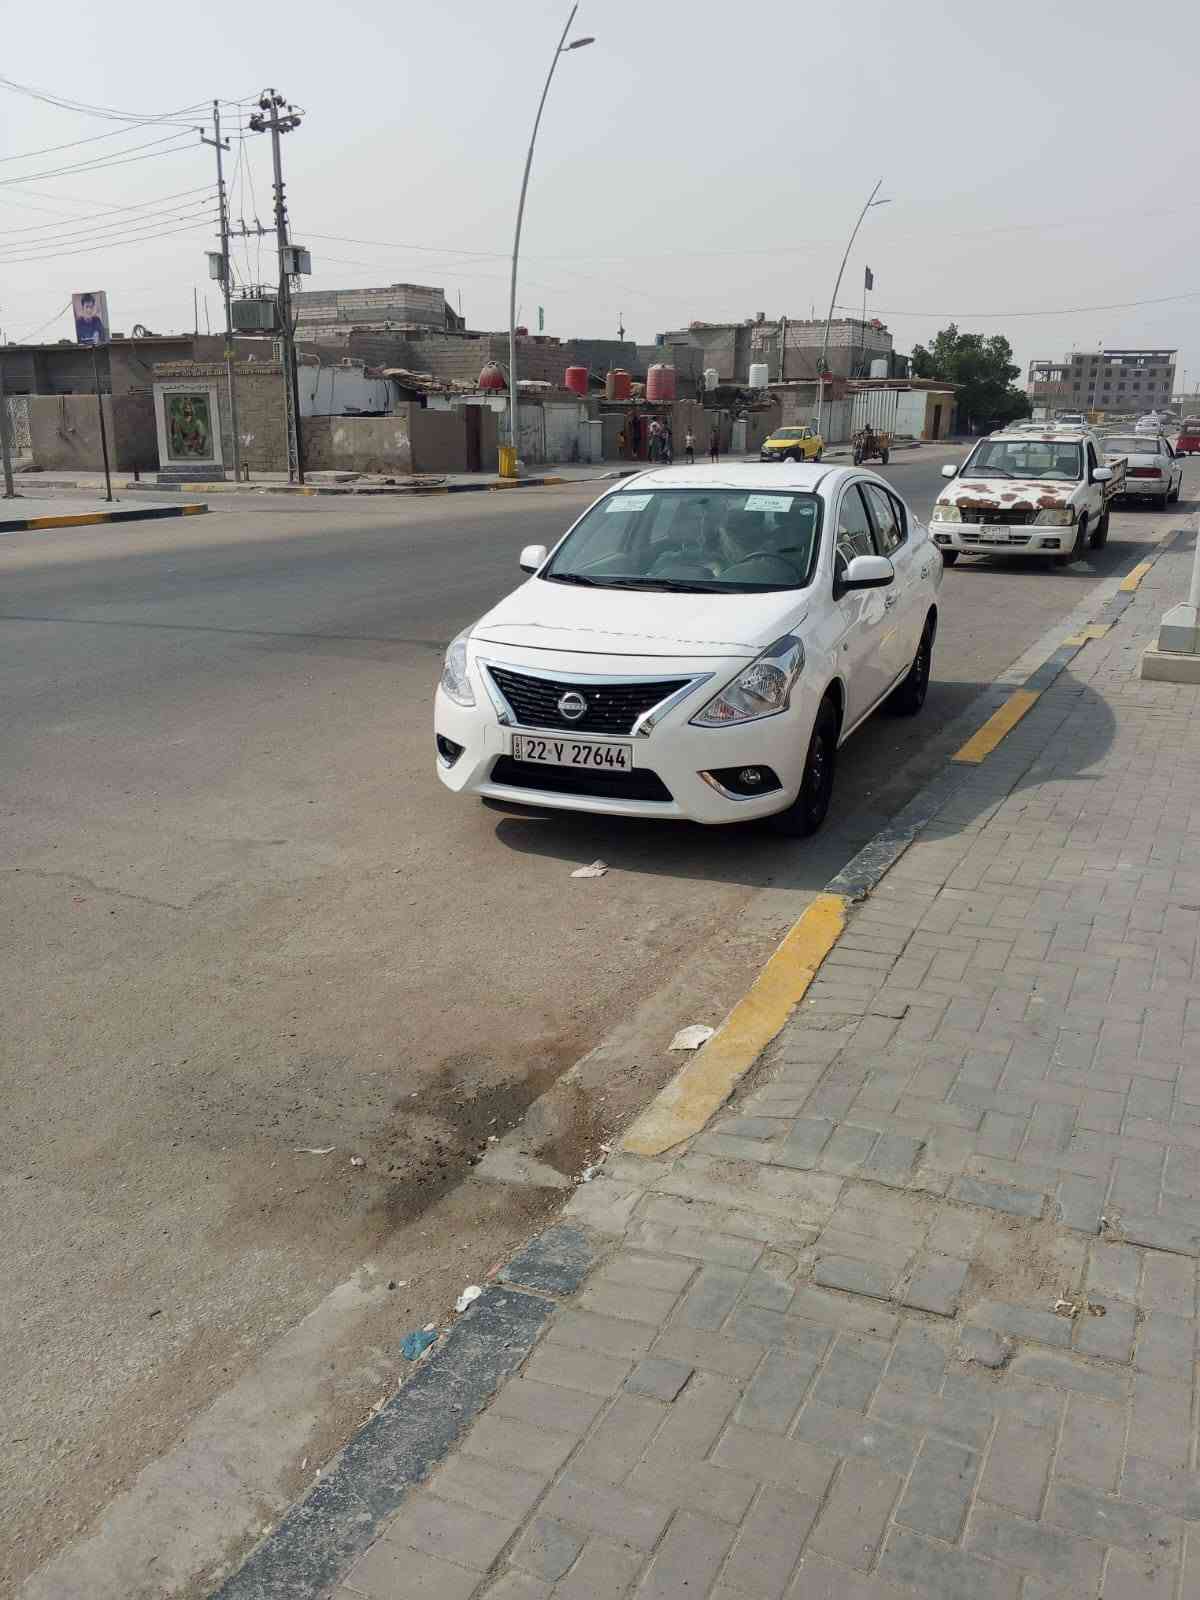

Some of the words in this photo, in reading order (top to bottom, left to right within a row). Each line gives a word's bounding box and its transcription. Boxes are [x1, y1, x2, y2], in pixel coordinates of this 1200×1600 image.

[527, 740, 546, 760] 22
[553, 742, 564, 761] Y
[572, 745, 626, 767] 27644
